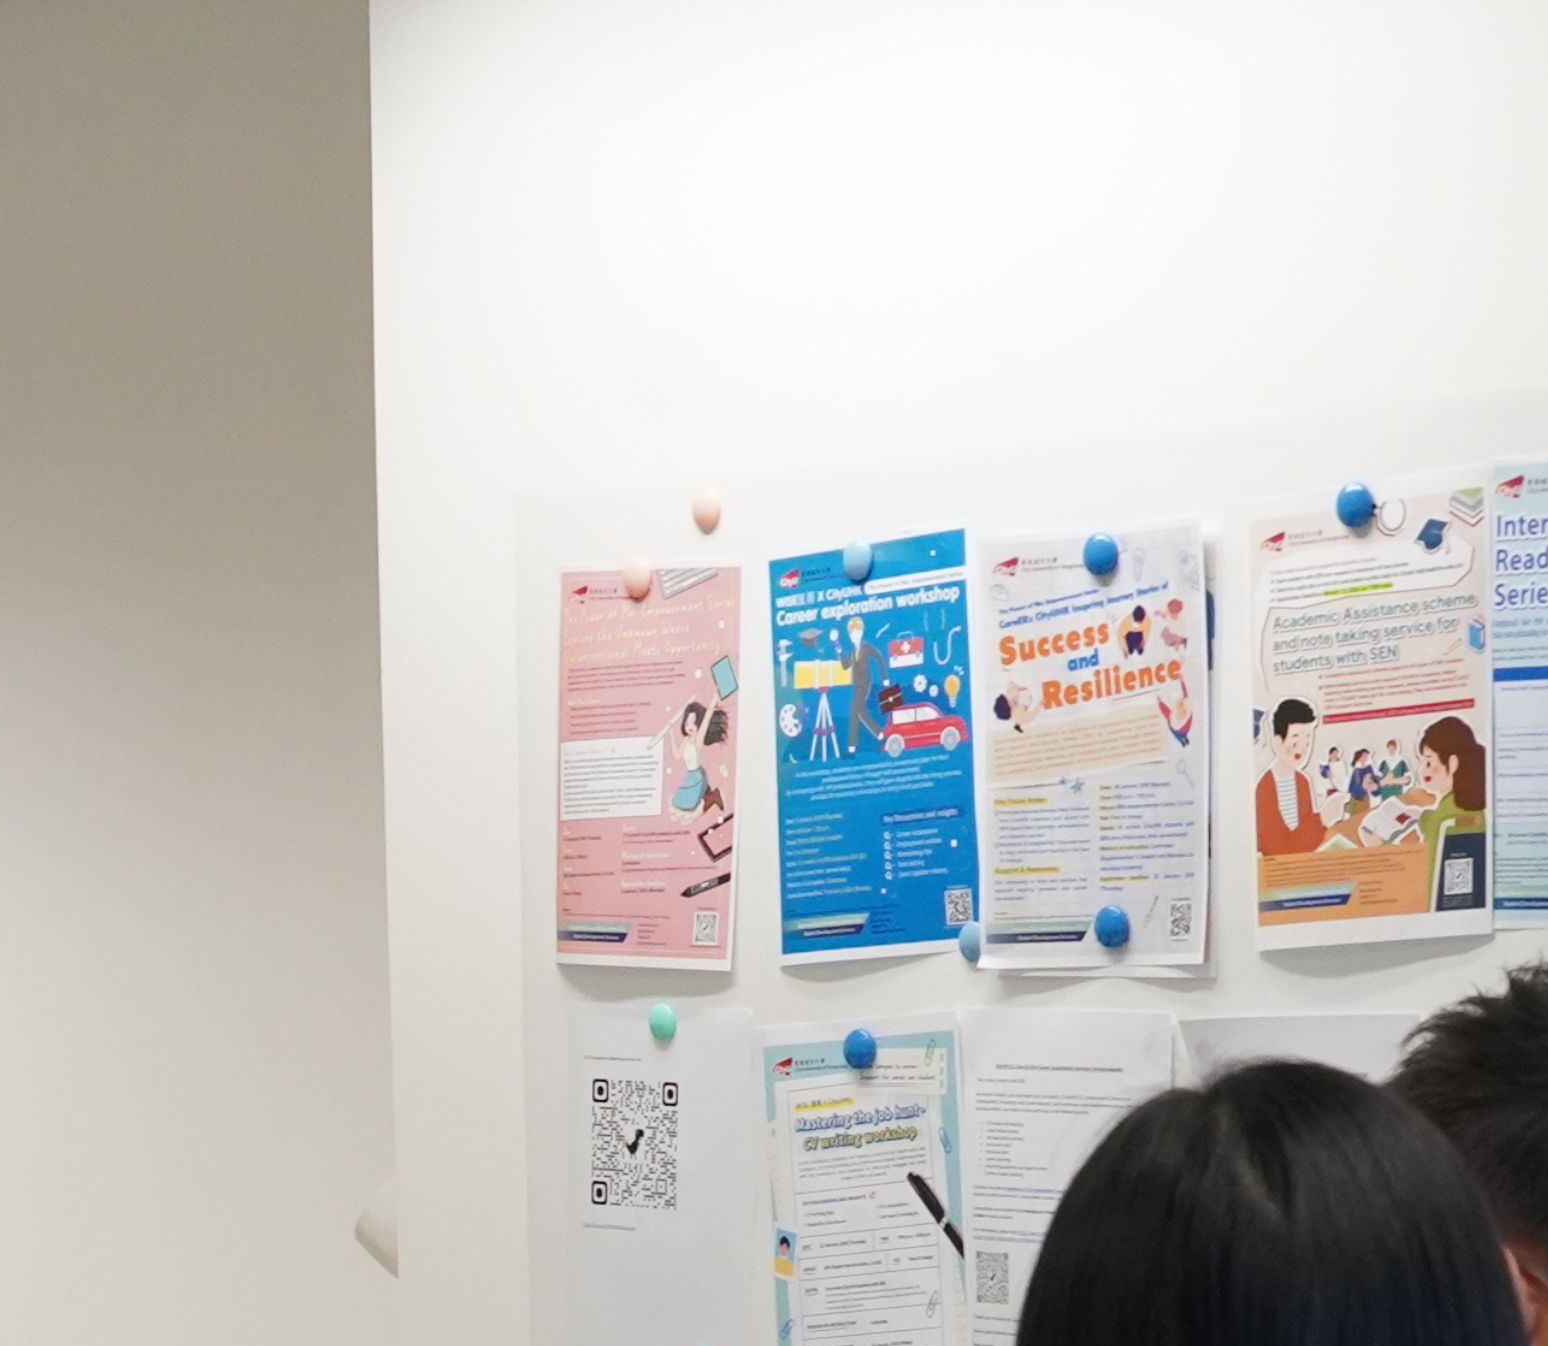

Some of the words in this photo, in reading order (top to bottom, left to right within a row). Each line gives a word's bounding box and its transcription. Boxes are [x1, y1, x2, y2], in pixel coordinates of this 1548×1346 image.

[776, 607, 819, 626] Career
[821, 596, 892, 621] exploration
[896, 586, 960, 605] workshop
[1273, 613, 1340, 630] Academic
[1343, 601, 1420, 621] Assistance
[1422, 593, 1477, 611] scheme
[999, 623, 1110, 666] Success
[1273, 636, 1296, 651] and
[1300, 633, 1331, 648] note
[1335, 627, 1380, 645] taking
[1383, 621, 1433, 637] service
[1437, 616, 1458, 630] for
[1067, 648, 1100, 671] and
[1273, 655, 1331, 672] students
[1336, 650, 1364, 664] with
[1370, 645, 1397, 660] SEN
[1041, 660, 1182, 710] Resilience
[794, 1111, 853, 1132] Mastering
[854, 1108, 873, 1125] the
[874, 1106, 893, 1125] job
[819, 1131, 862, 1149] writing
[864, 1125, 918, 1145] workshop
